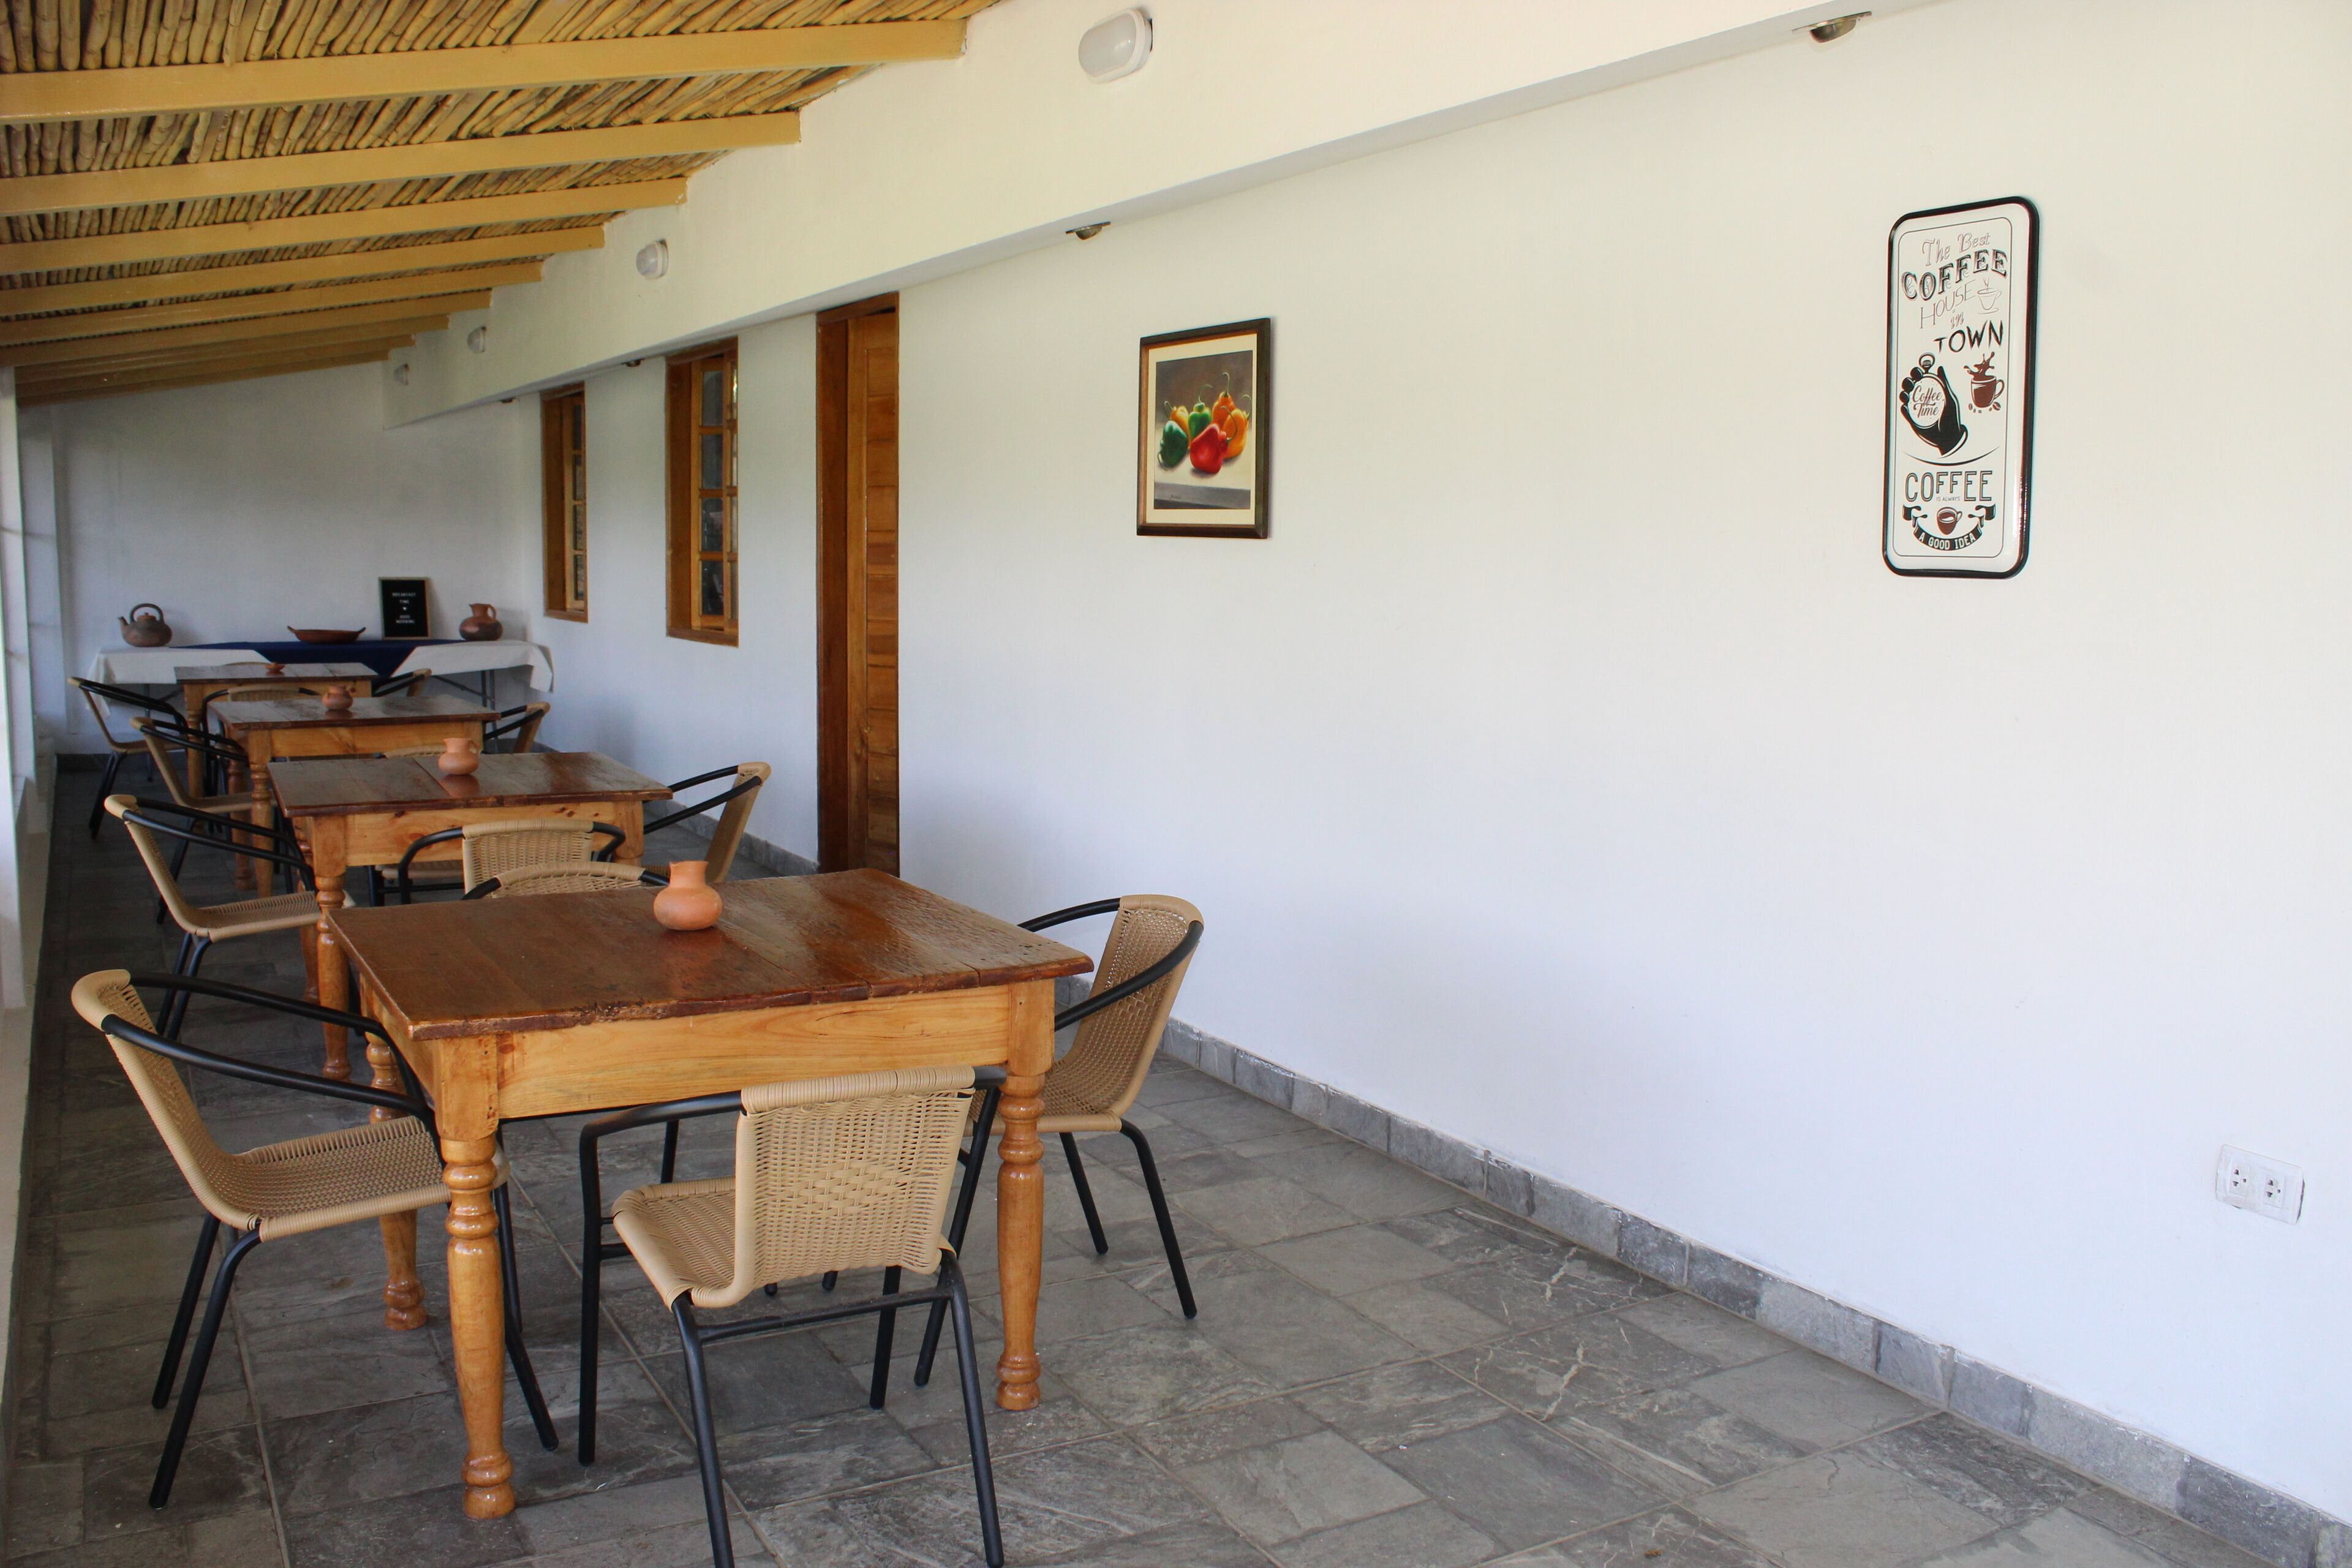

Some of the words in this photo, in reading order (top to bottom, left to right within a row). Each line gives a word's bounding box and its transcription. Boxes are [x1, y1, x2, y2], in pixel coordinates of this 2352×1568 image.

[1922, 238, 1950, 266] The
[1958, 232, 1991, 252] Best
[1901, 249, 2008, 301] COFFEE
[1920, 279, 1975, 329] HOUSE
[1950, 309, 1964, 329] in
[1933, 320, 2003, 353] TOWN
[1912, 385, 1942, 406] Coffee
[1913, 402, 1939, 418] Time
[1905, 470, 1992, 502] COFFEE
[1919, 532, 1925, 542] A
[1928, 537, 1950, 550] GOOD
[1955, 533, 1976, 549] IDEA
